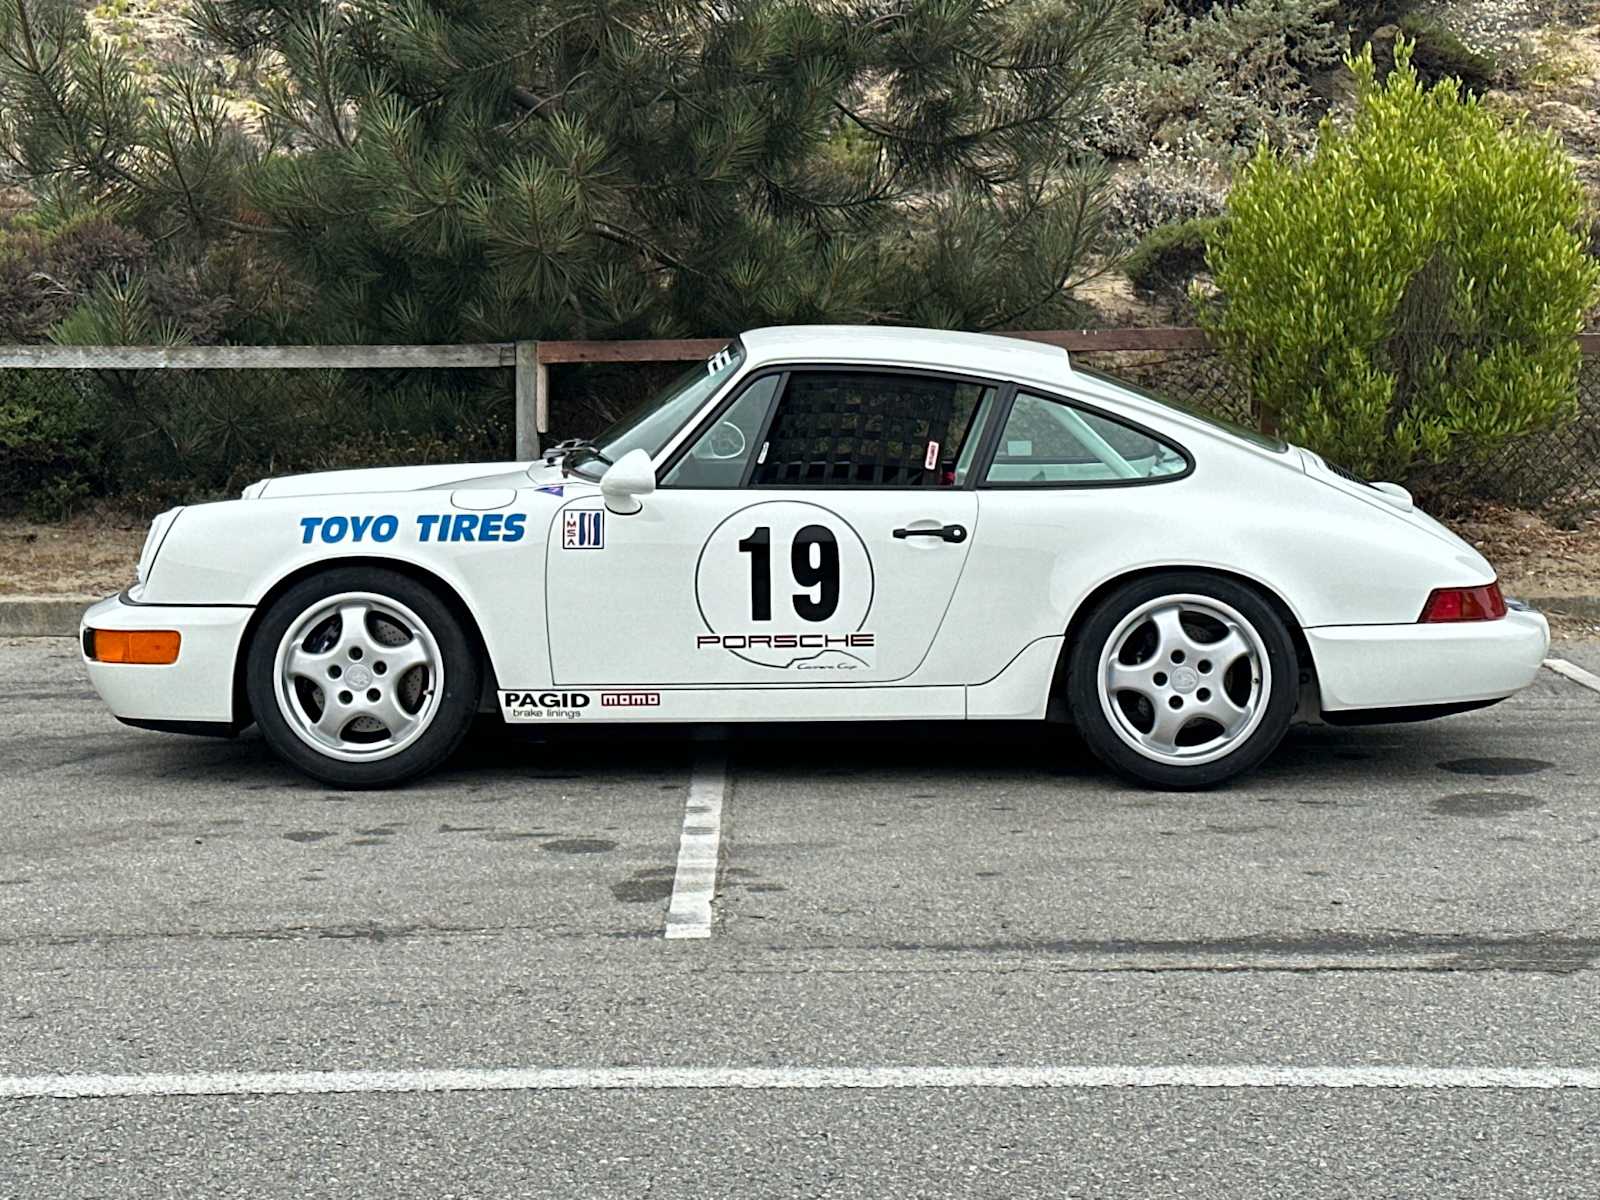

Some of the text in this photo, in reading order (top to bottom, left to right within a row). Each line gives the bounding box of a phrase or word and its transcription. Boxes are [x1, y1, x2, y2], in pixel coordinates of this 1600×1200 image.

[300, 513, 527, 544] TOYO TIRES
[739, 524, 840, 622] 19
[697, 634, 874, 649] PORSCHE
[505, 693, 590, 708] PAGID
[513, 709, 581, 719] brake linings
